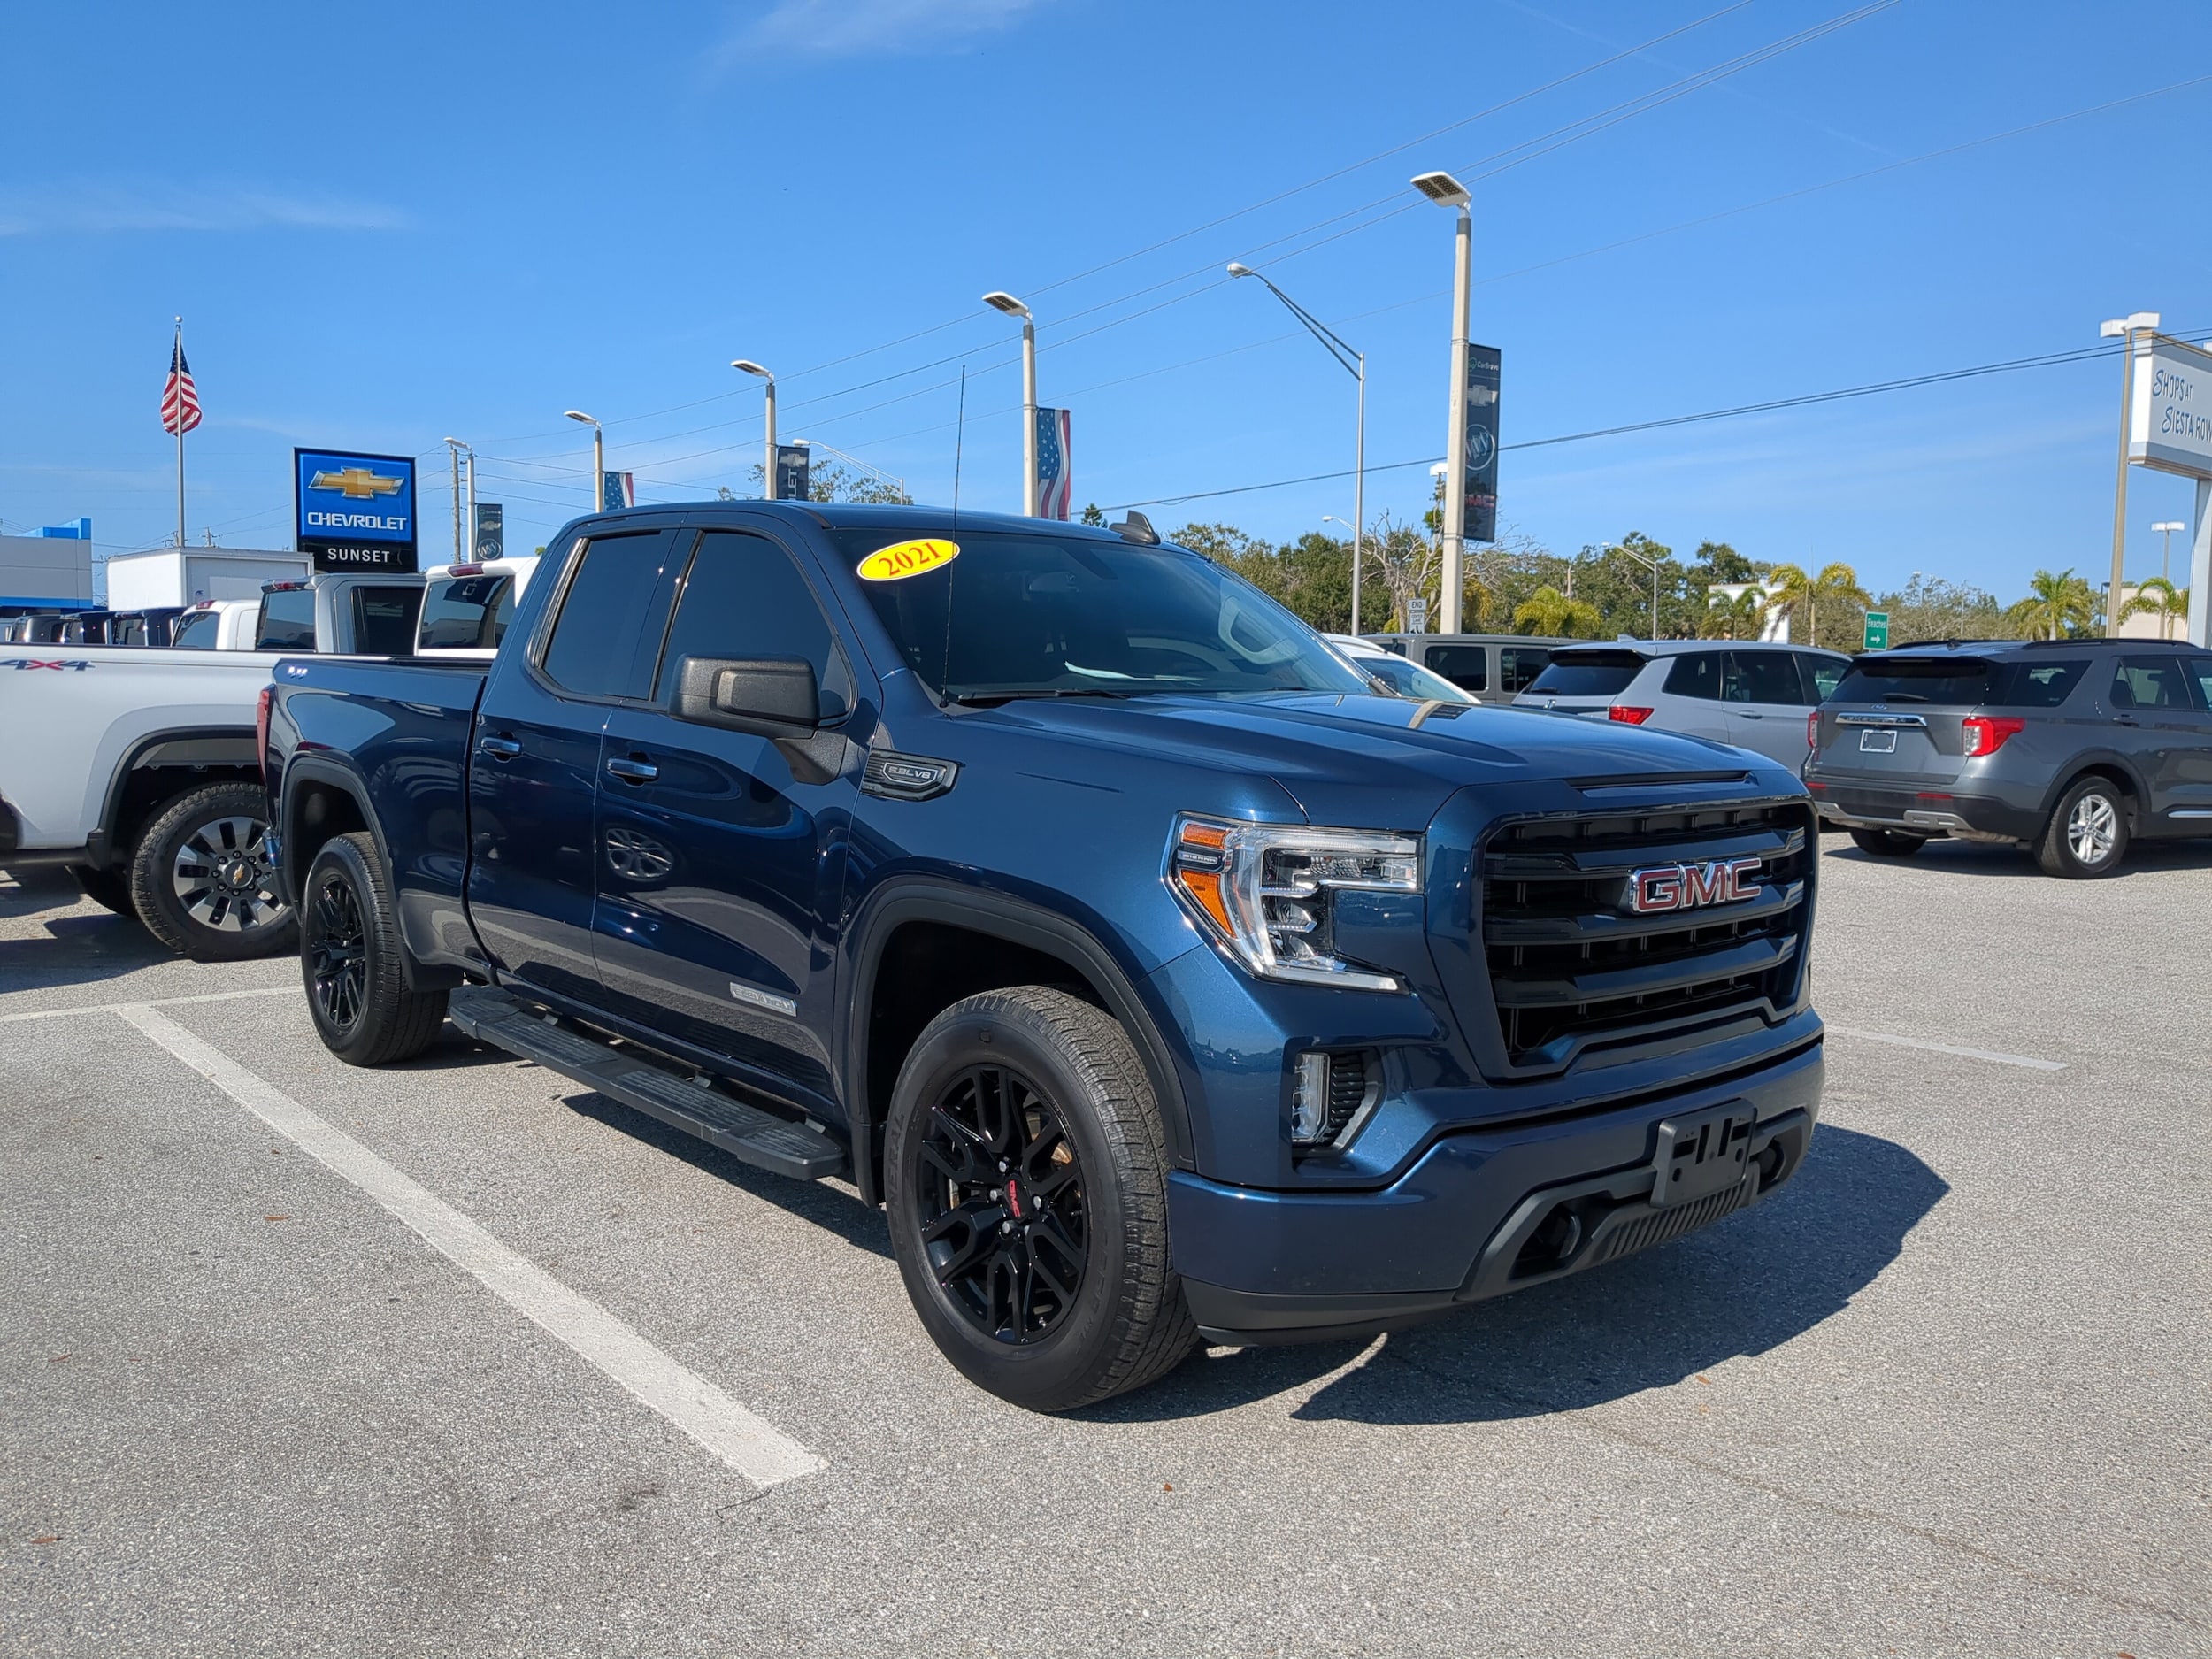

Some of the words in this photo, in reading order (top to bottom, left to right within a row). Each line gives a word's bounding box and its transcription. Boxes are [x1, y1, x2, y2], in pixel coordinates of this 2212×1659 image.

[2153, 369, 2185, 402] SHOPS
[2185, 383, 2193, 401] AT
[2162, 406, 2193, 438] SIESTA
[1465, 495, 1495, 508] MC
[307, 511, 407, 531] CHEVROLET
[327, 547, 390, 563] SUNSET
[878, 541, 941, 577] 2021
[1631, 856, 1762, 913] GMC
[1009, 1179, 1021, 1217] GMC
